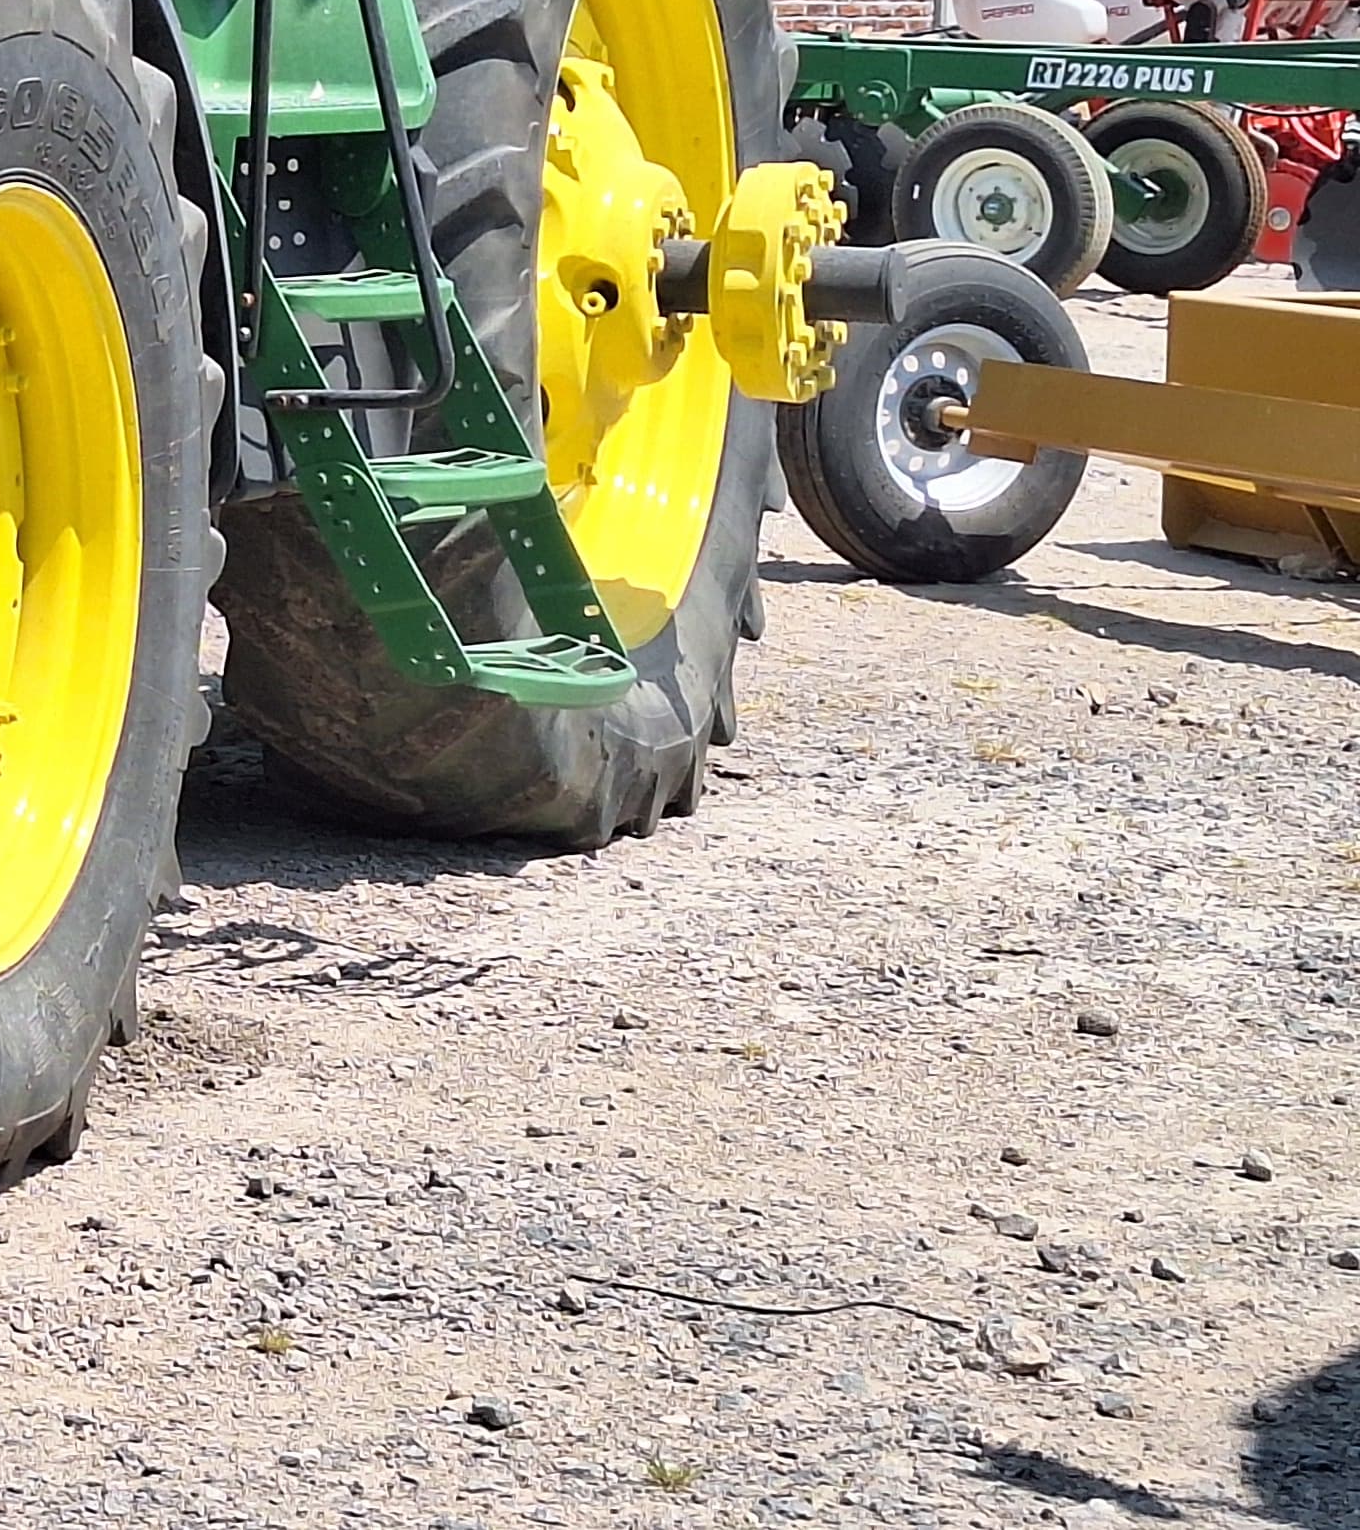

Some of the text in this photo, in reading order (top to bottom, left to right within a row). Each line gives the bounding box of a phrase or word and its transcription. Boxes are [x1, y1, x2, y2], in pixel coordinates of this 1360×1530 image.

[1030, 59, 1215, 94] RT 2226 PLUS 1
